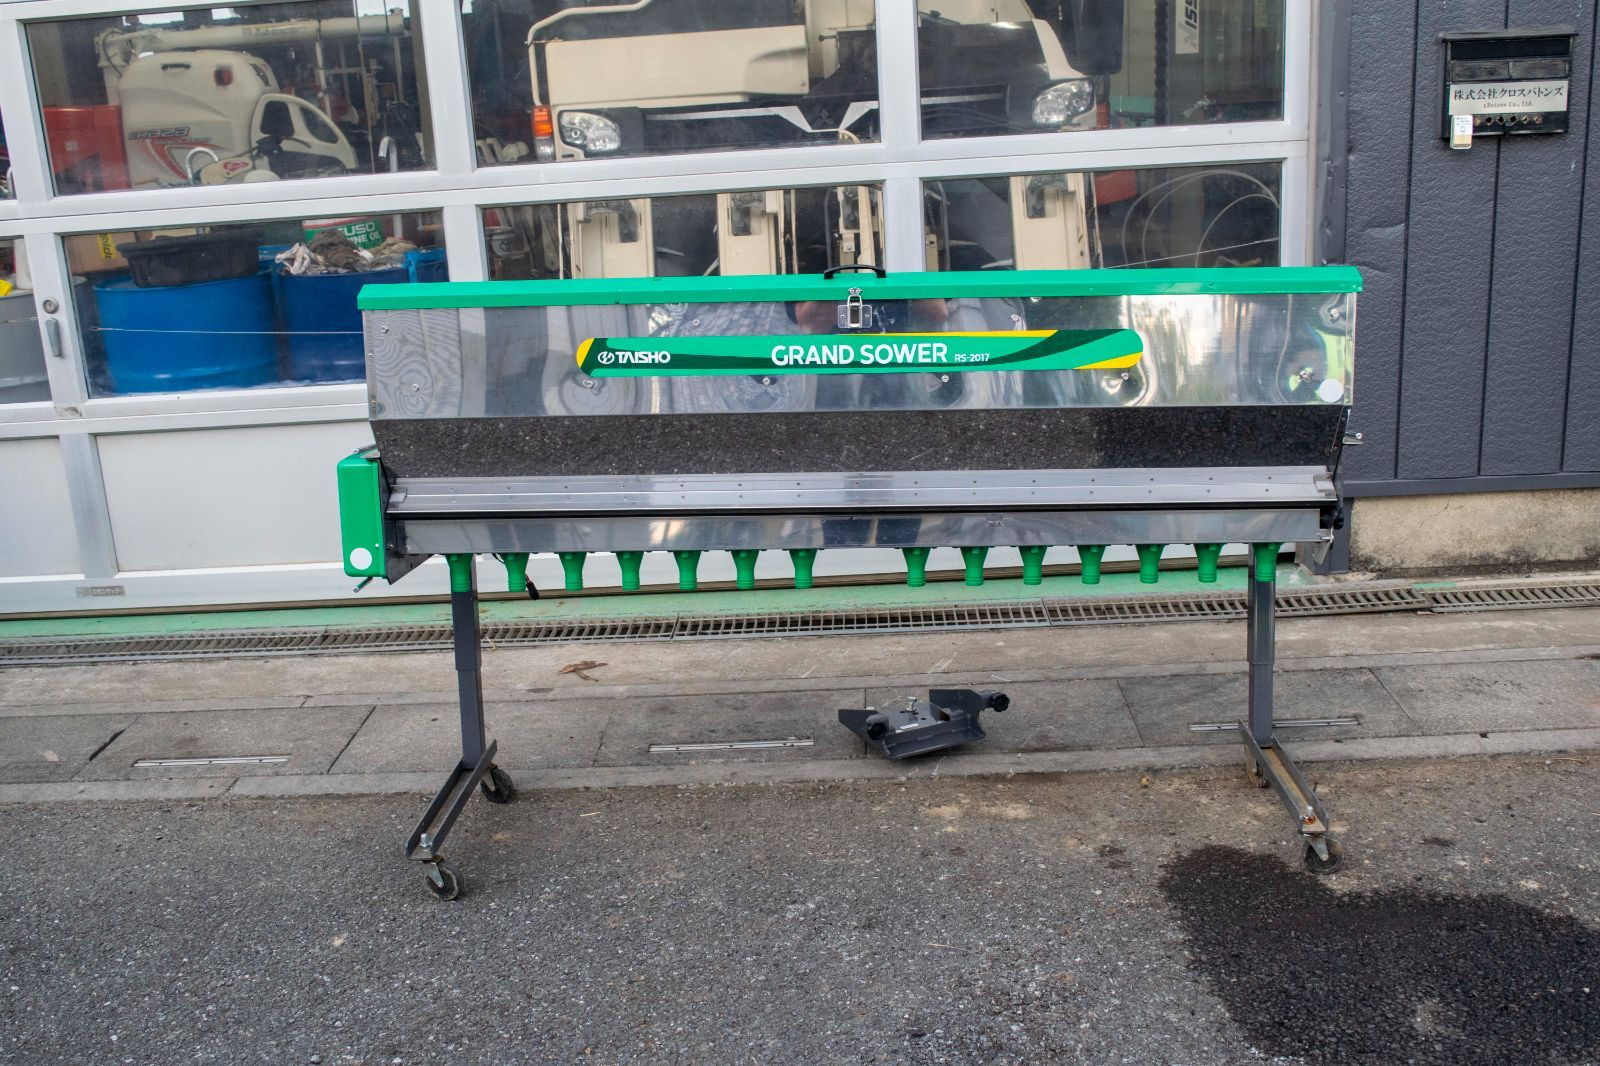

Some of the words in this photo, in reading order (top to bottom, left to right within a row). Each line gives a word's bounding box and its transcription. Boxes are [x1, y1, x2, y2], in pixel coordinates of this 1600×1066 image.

[1453, 85, 1564, 101] 株式会社クロスバトンズ
[615, 350, 671, 364] TAISHO
[771, 344, 854, 366] GRAND
[860, 342, 948, 365] SOWER
[954, 353, 990, 362] RS-2017
